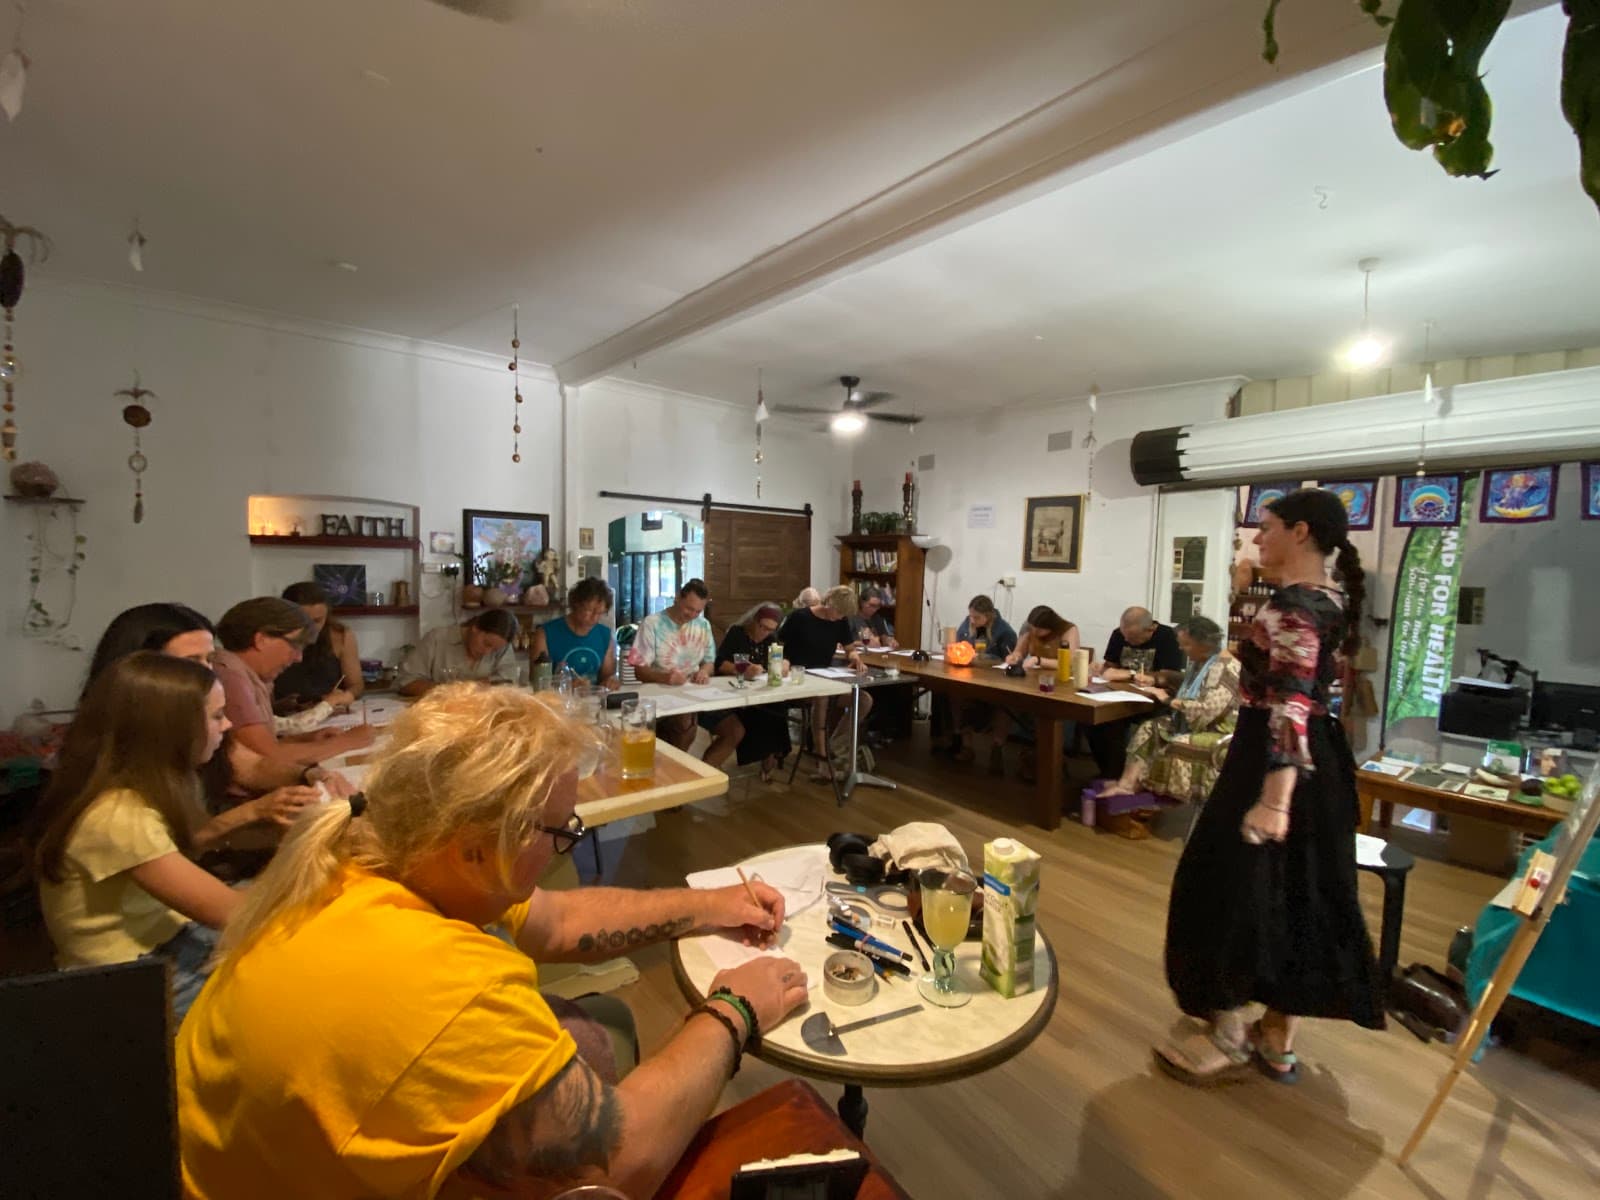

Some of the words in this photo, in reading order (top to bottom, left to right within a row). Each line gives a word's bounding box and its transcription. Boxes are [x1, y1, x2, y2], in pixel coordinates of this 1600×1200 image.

[320, 514, 405, 537] FAITH
[1440, 526, 1459, 567] MP
[1430, 574, 1452, 617] FOR
[1422, 623, 1445, 703] HEALTH
